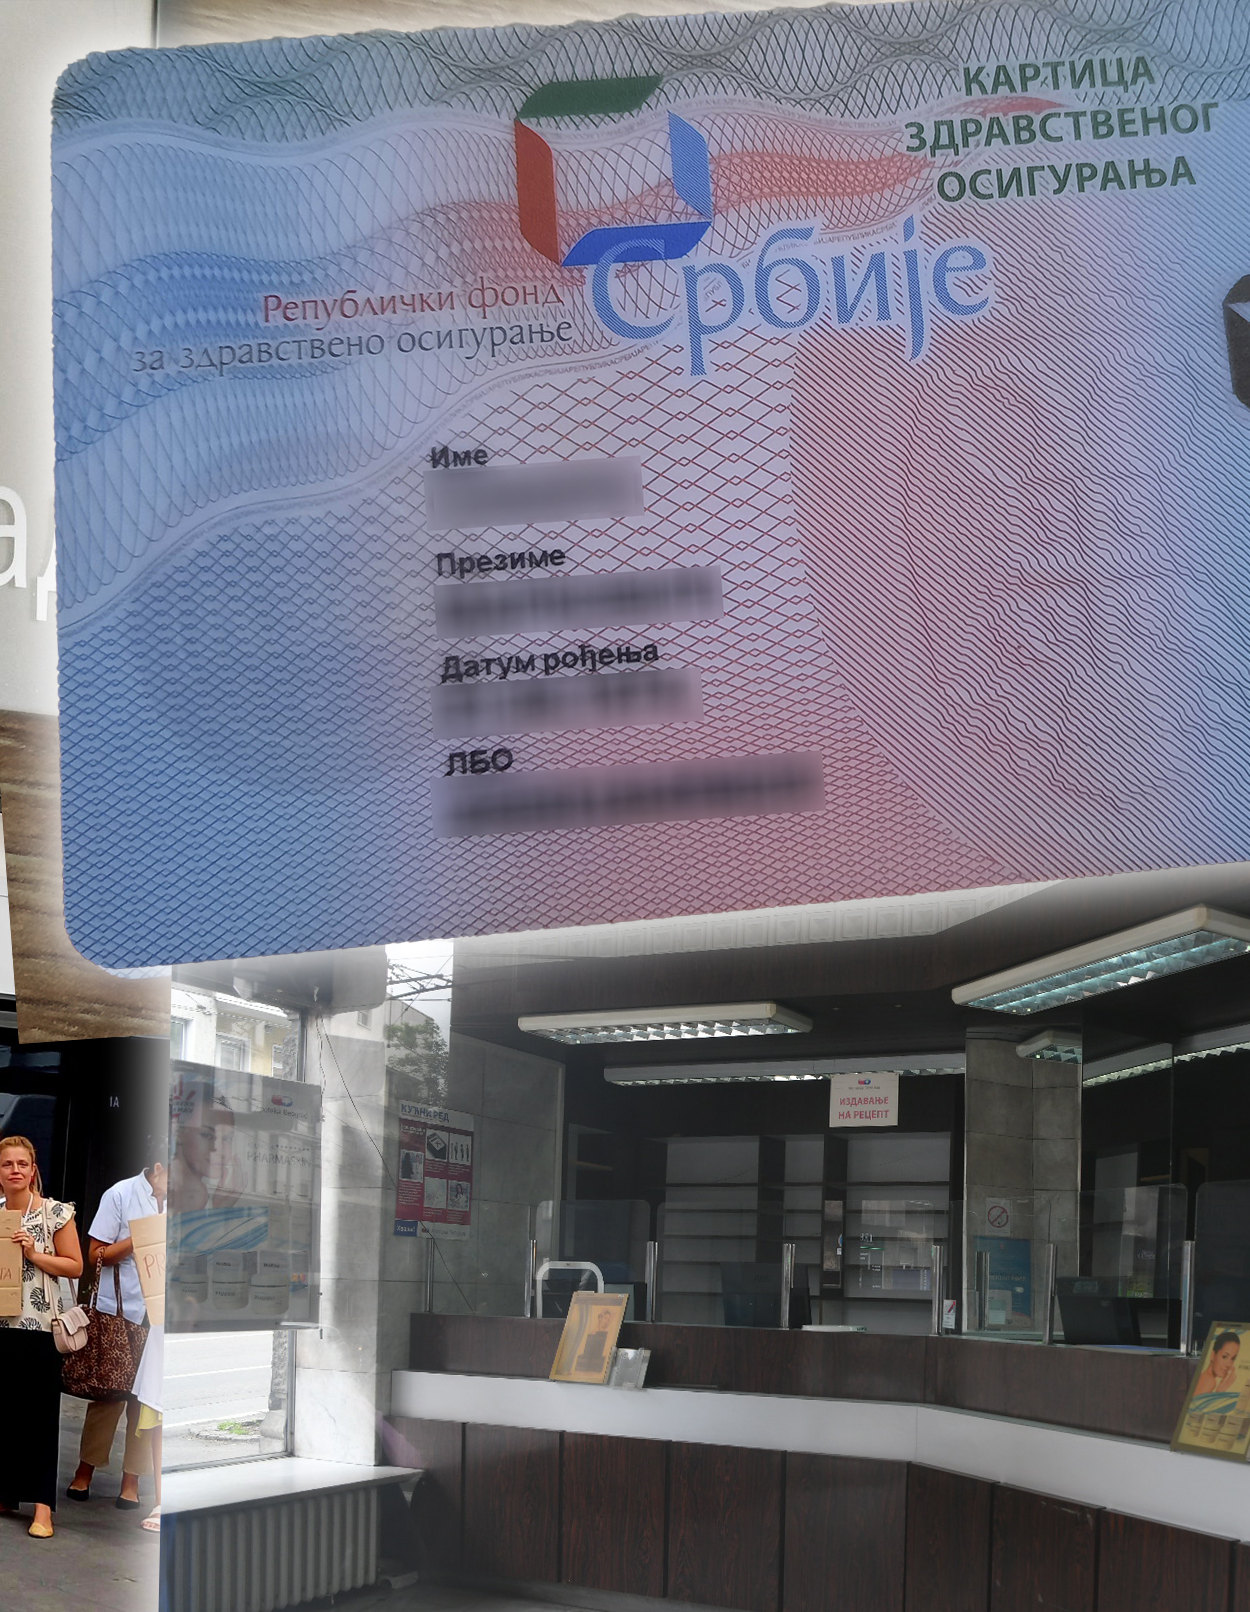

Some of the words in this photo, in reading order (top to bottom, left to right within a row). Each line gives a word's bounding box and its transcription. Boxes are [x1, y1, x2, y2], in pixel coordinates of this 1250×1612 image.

[963, 56, 1156, 96] КАРТИЦА
[904, 103, 1219, 157] ЗДРАВСТВЕНОГ
[936, 155, 1197, 203] ОСИГУРАЊА
[262, 288, 456, 331] Републички
[467, 276, 566, 319] фонд
[591, 214, 990, 376] Србије
[133, 349, 165, 373] за
[179, 334, 385, 377] здравствено
[396, 319, 574, 361] осигурање
[430, 445, 490, 469] Име
[436, 547, 567, 580] Презиме
[440, 652, 536, 684] Датум
[543, 642, 660, 676] рођења
[446, 747, 514, 778] ЛБО
[433, 1111, 450, 1123] РЕД
[838, 1110, 852, 1120] НА
[853, 1109, 890, 1121] РЕЦЕПТ
[839, 1096, 889, 1107] ИЗДАВАЊЕ
